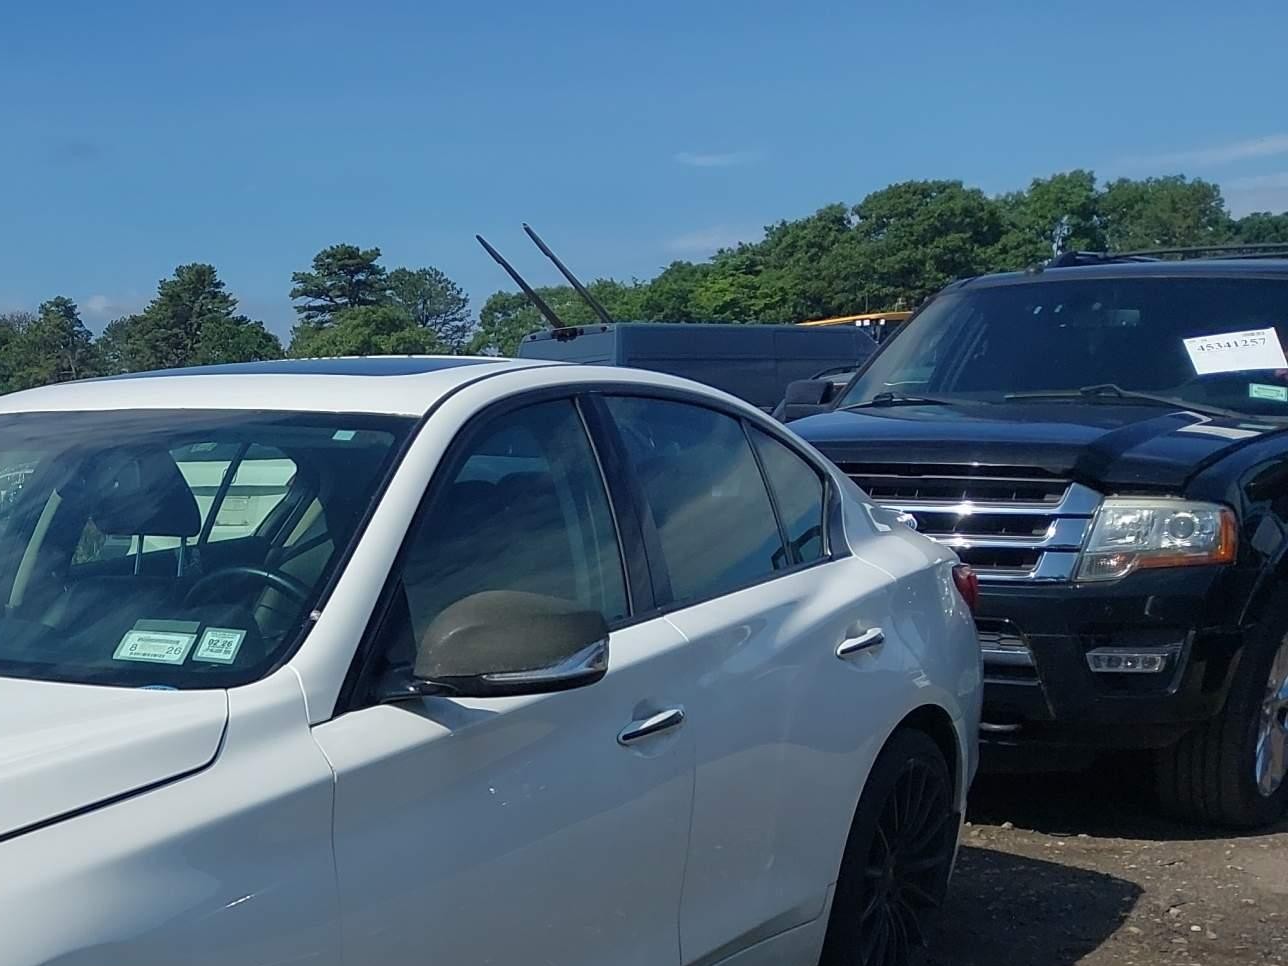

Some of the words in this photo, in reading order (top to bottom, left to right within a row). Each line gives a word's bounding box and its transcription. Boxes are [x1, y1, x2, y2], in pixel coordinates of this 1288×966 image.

[1196, 337, 1266, 352] 45341257
[129, 643, 138, 652] 8
[166, 646, 183, 655] 26
